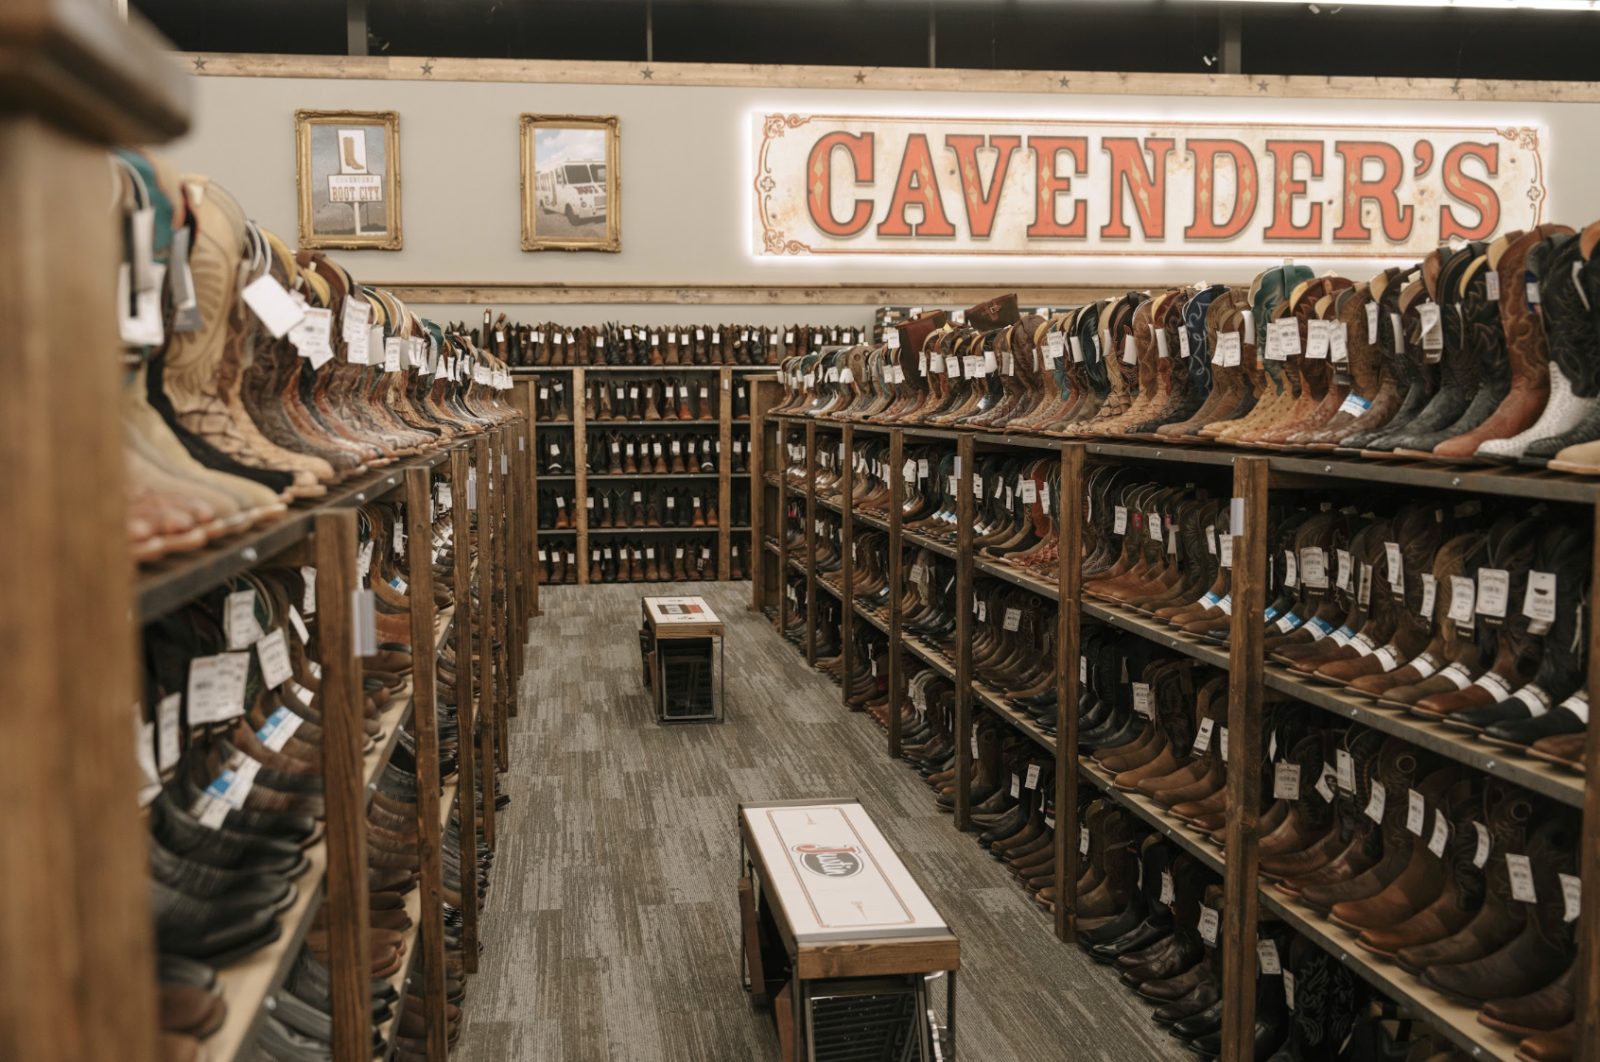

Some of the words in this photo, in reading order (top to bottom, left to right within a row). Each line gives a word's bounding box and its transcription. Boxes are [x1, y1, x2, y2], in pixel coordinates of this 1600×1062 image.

[332, 186, 355, 201] BOOT
[360, 186, 380, 201] CITY
[805, 130, 1501, 242] CAVENDER'S
